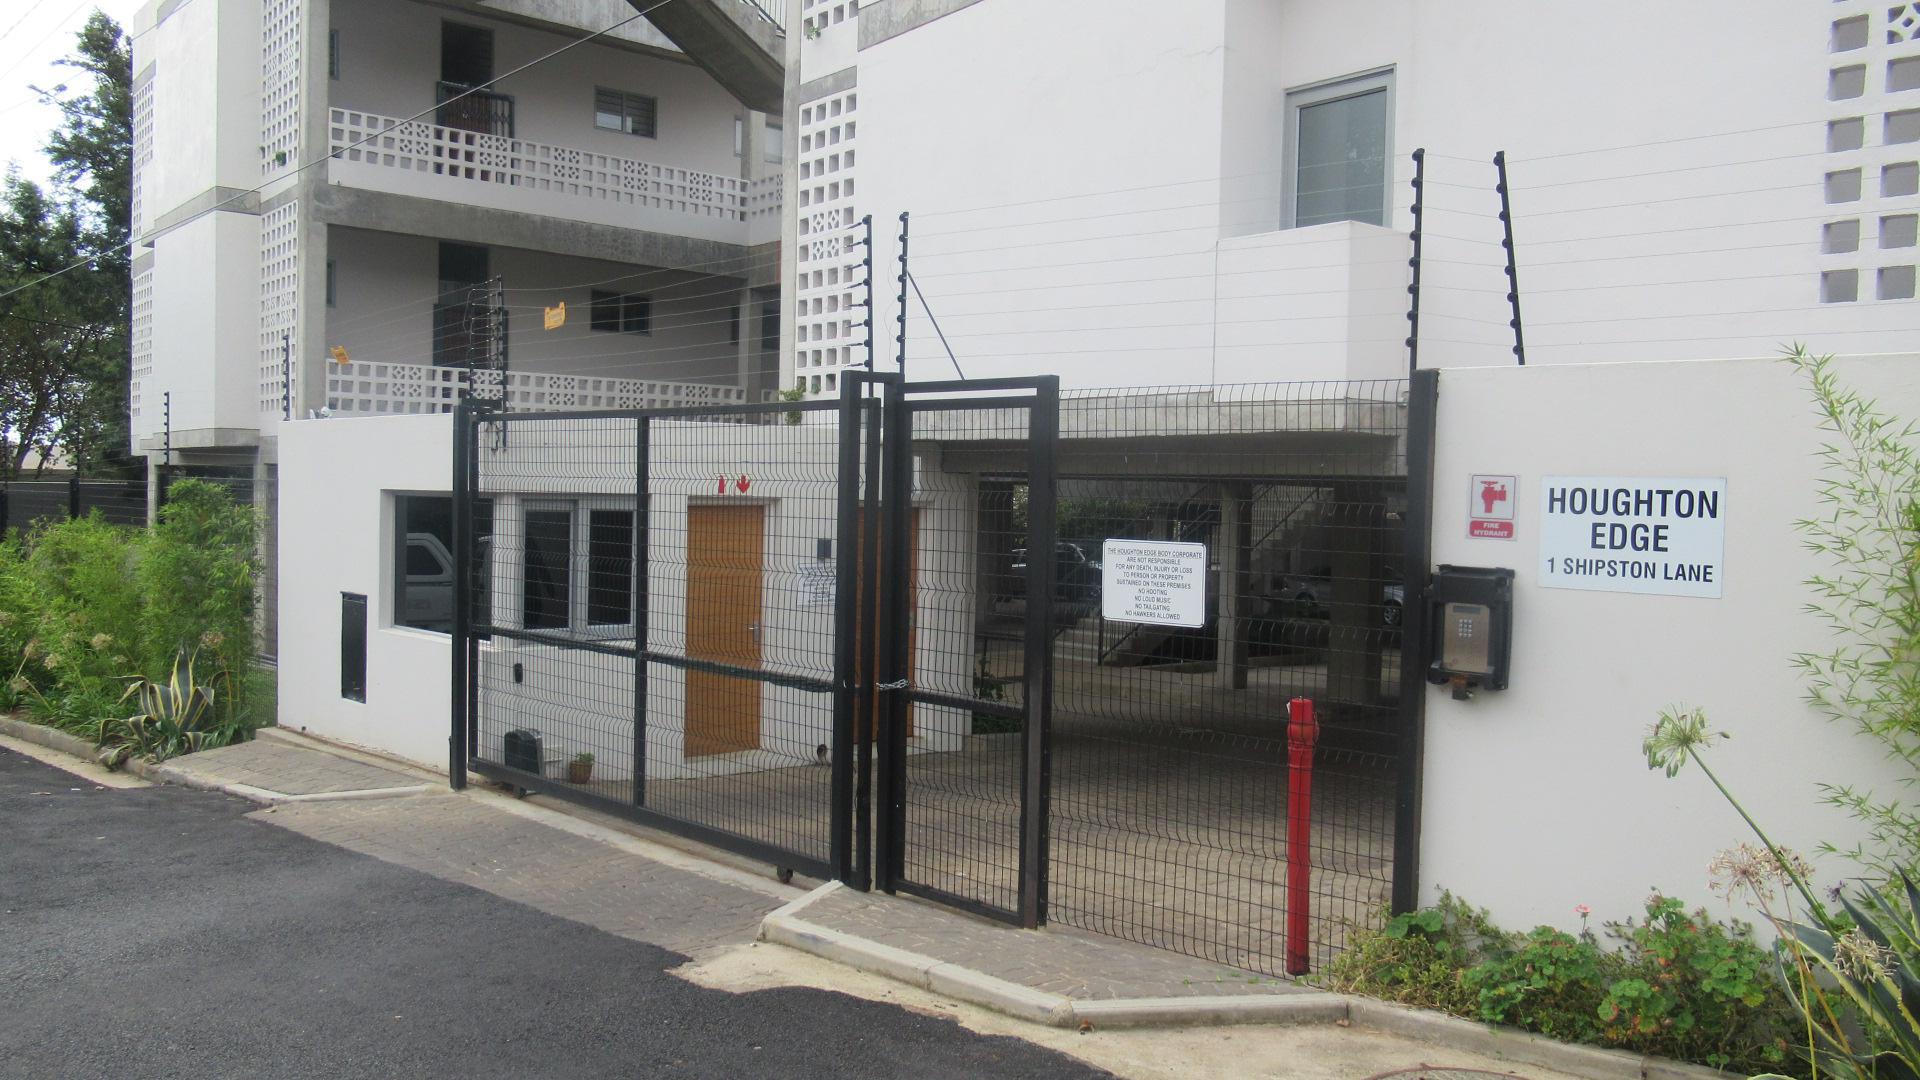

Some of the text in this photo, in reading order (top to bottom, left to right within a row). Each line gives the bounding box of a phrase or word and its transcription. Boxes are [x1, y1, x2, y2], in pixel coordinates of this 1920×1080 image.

[1548, 487, 1718, 518] HOUGHTON
[1473, 529, 1508, 537] HYDRANT
[1591, 522, 1668, 552] EDGE
[1548, 557, 1713, 582] 1 SHIPSTON LANE
